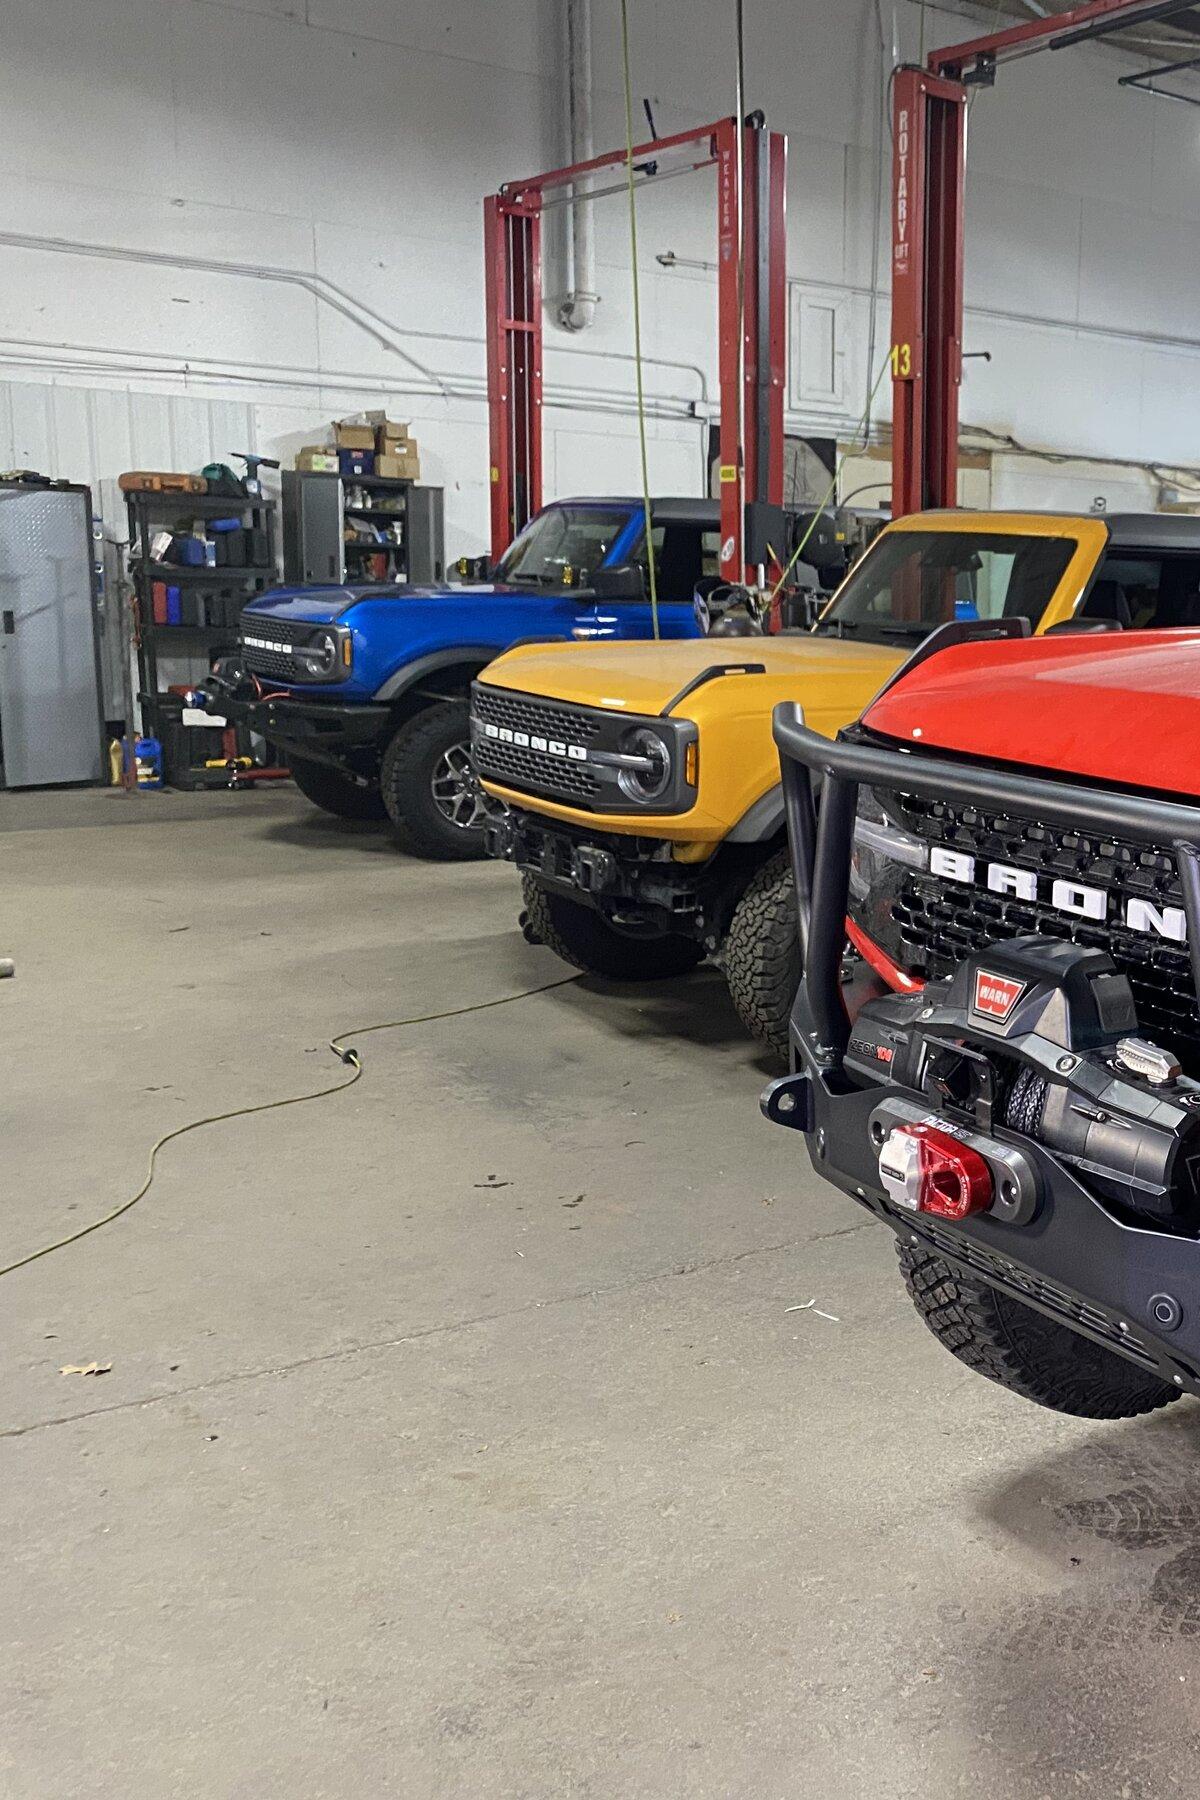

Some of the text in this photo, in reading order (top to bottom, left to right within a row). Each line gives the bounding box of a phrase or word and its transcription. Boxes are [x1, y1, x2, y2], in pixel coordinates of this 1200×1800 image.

[897, 110, 909, 242] ROTARY
[891, 344, 911, 377] 13
[485, 723, 587, 761] BRONCO
[979, 985, 1011, 1007] WARN
[960, 1175, 970, 1212] WARNING
